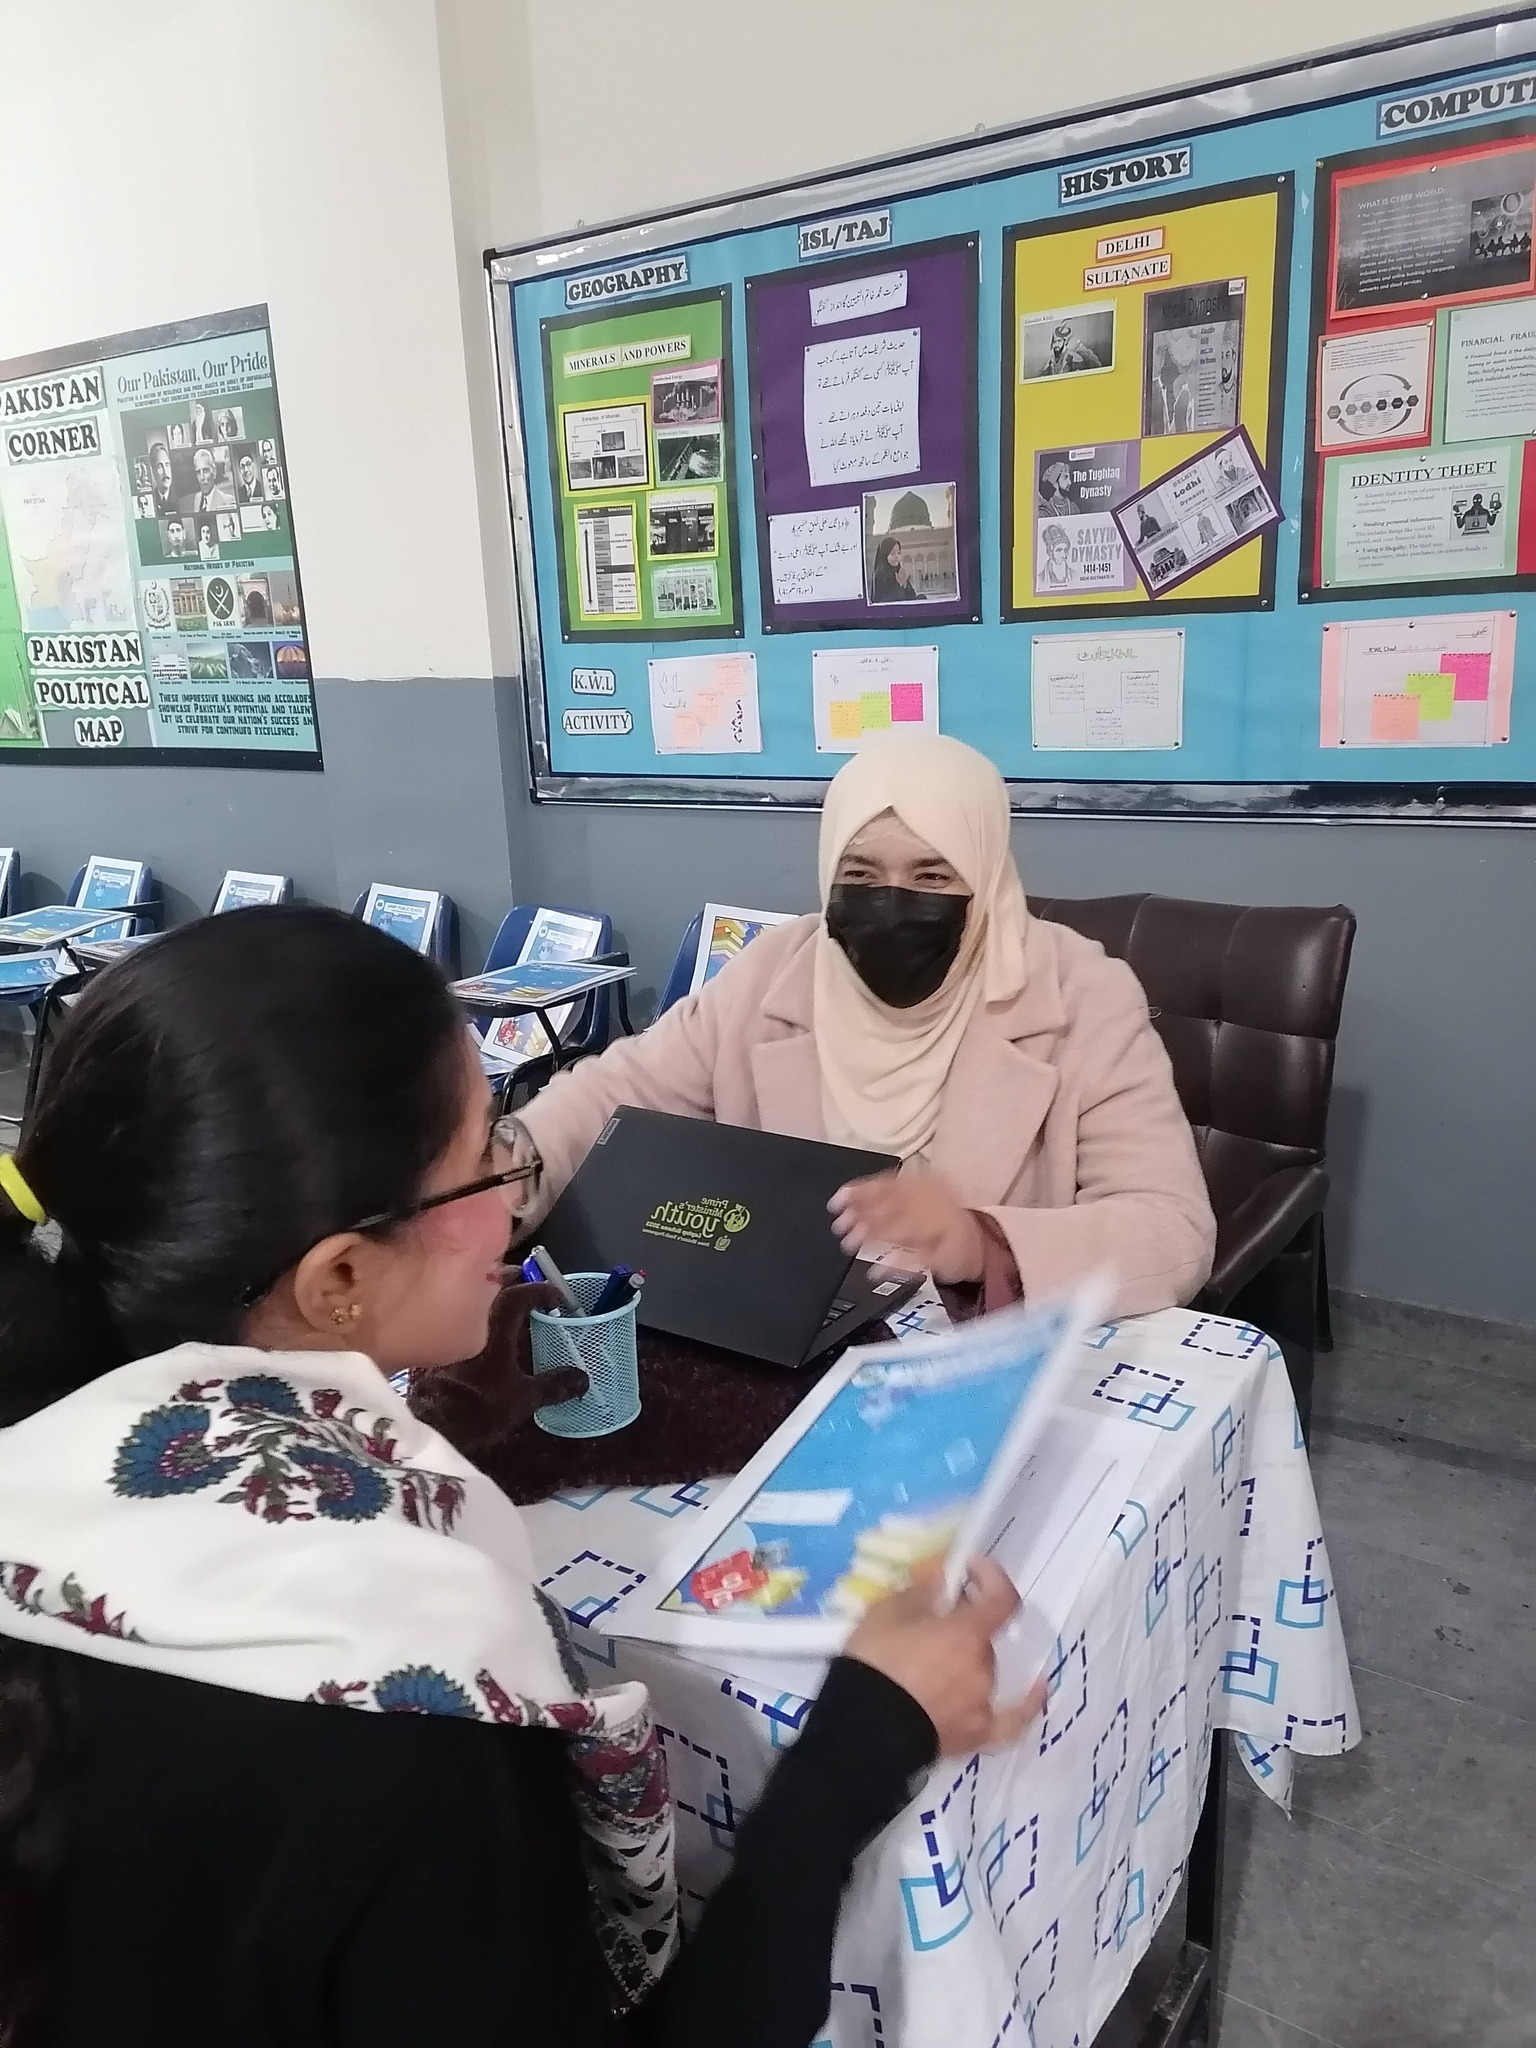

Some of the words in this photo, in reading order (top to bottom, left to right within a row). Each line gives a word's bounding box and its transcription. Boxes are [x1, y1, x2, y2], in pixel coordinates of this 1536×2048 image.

[1064, 151, 1187, 198] HISTORY
[1358, 199, 1380, 209] WHAT
[1390, 193, 1413, 204] CYBER
[802, 217, 888, 251] ISL/TAJ
[1105, 235, 1151, 255] DELHI
[569, 262, 684, 301] GEOGRAPHY
[1086, 261, 1168, 286] SULTANATE
[1461, 335, 1504, 347] FINANCIAL
[569, 353, 616, 371] MINERALS
[622, 349, 642, 362] AND
[644, 340, 687, 358] POWERS
[118, 375, 141, 394] Our
[203, 360, 228, 379] Our
[230, 351, 268, 374] Pride
[0, 376, 99, 416] AKISTAN
[9, 424, 97, 457] CORNER
[1073, 470, 1087, 483] The
[1088, 467, 1120, 483] Tughlaq
[1351, 467, 1433, 488] IDENTITY
[1438, 460, 1497, 478] THEFT
[1080, 484, 1112, 499] Dynasty
[1173, 476, 1203, 499] Lodhi
[1077, 526, 1117, 546] SAYYID
[1071, 543, 1123, 564] DYNASTY
[231, 560, 255, 569] PAKISTAN
[1083, 562, 1111, 574] 1414-1451
[31, 638, 141, 663] PAKISTAN
[574, 674, 613, 691] K.W.L
[36, 681, 149, 705] POLITICAL
[159, 693, 178, 702] THESE
[257, 694, 271, 703] AND
[158, 704, 191, 713] SHOWCASE
[233, 705, 268, 714] POTENTIAL
[272, 705, 285, 714] AND
[160, 713, 171, 723] LET
[185, 715, 219, 724] CELEBRATE
[270, 716, 299, 725] SUCCESS
[77, 720, 123, 743] MAP
[177, 725, 198, 734] STRIVE
[216, 726, 251, 735] CONTINUED
[253, 726, 298, 736] EXCELLENCE.
[565, 714, 629, 730] ACTIVITY
